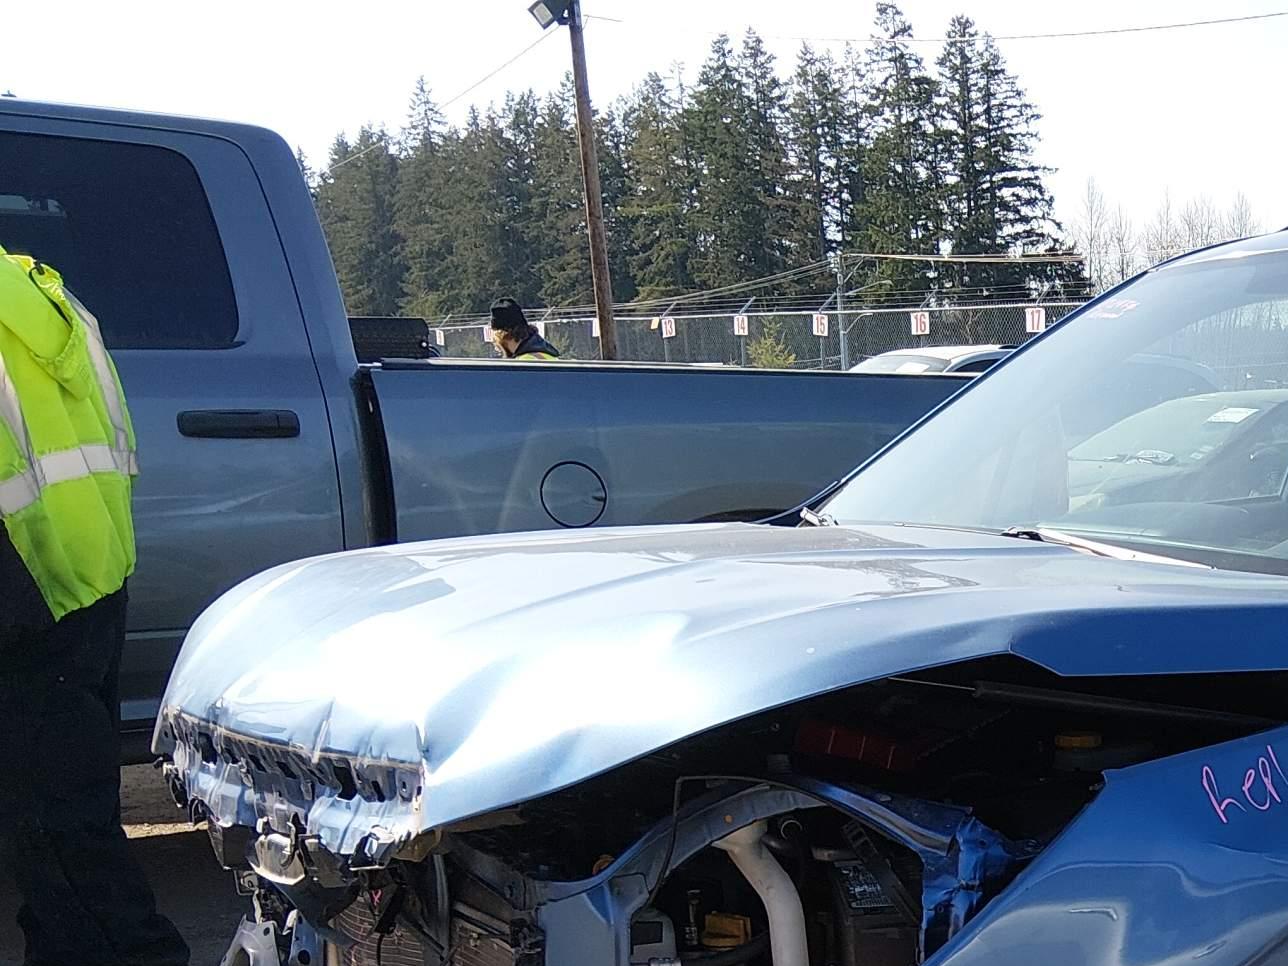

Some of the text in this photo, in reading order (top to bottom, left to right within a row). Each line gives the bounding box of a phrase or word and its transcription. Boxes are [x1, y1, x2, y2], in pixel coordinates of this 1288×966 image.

[664, 320, 674, 337] 13
[736, 316, 746, 334] 14
[815, 316, 826, 334] 15
[914, 315, 927, 333] 16
[1030, 310, 1041, 331] 17
